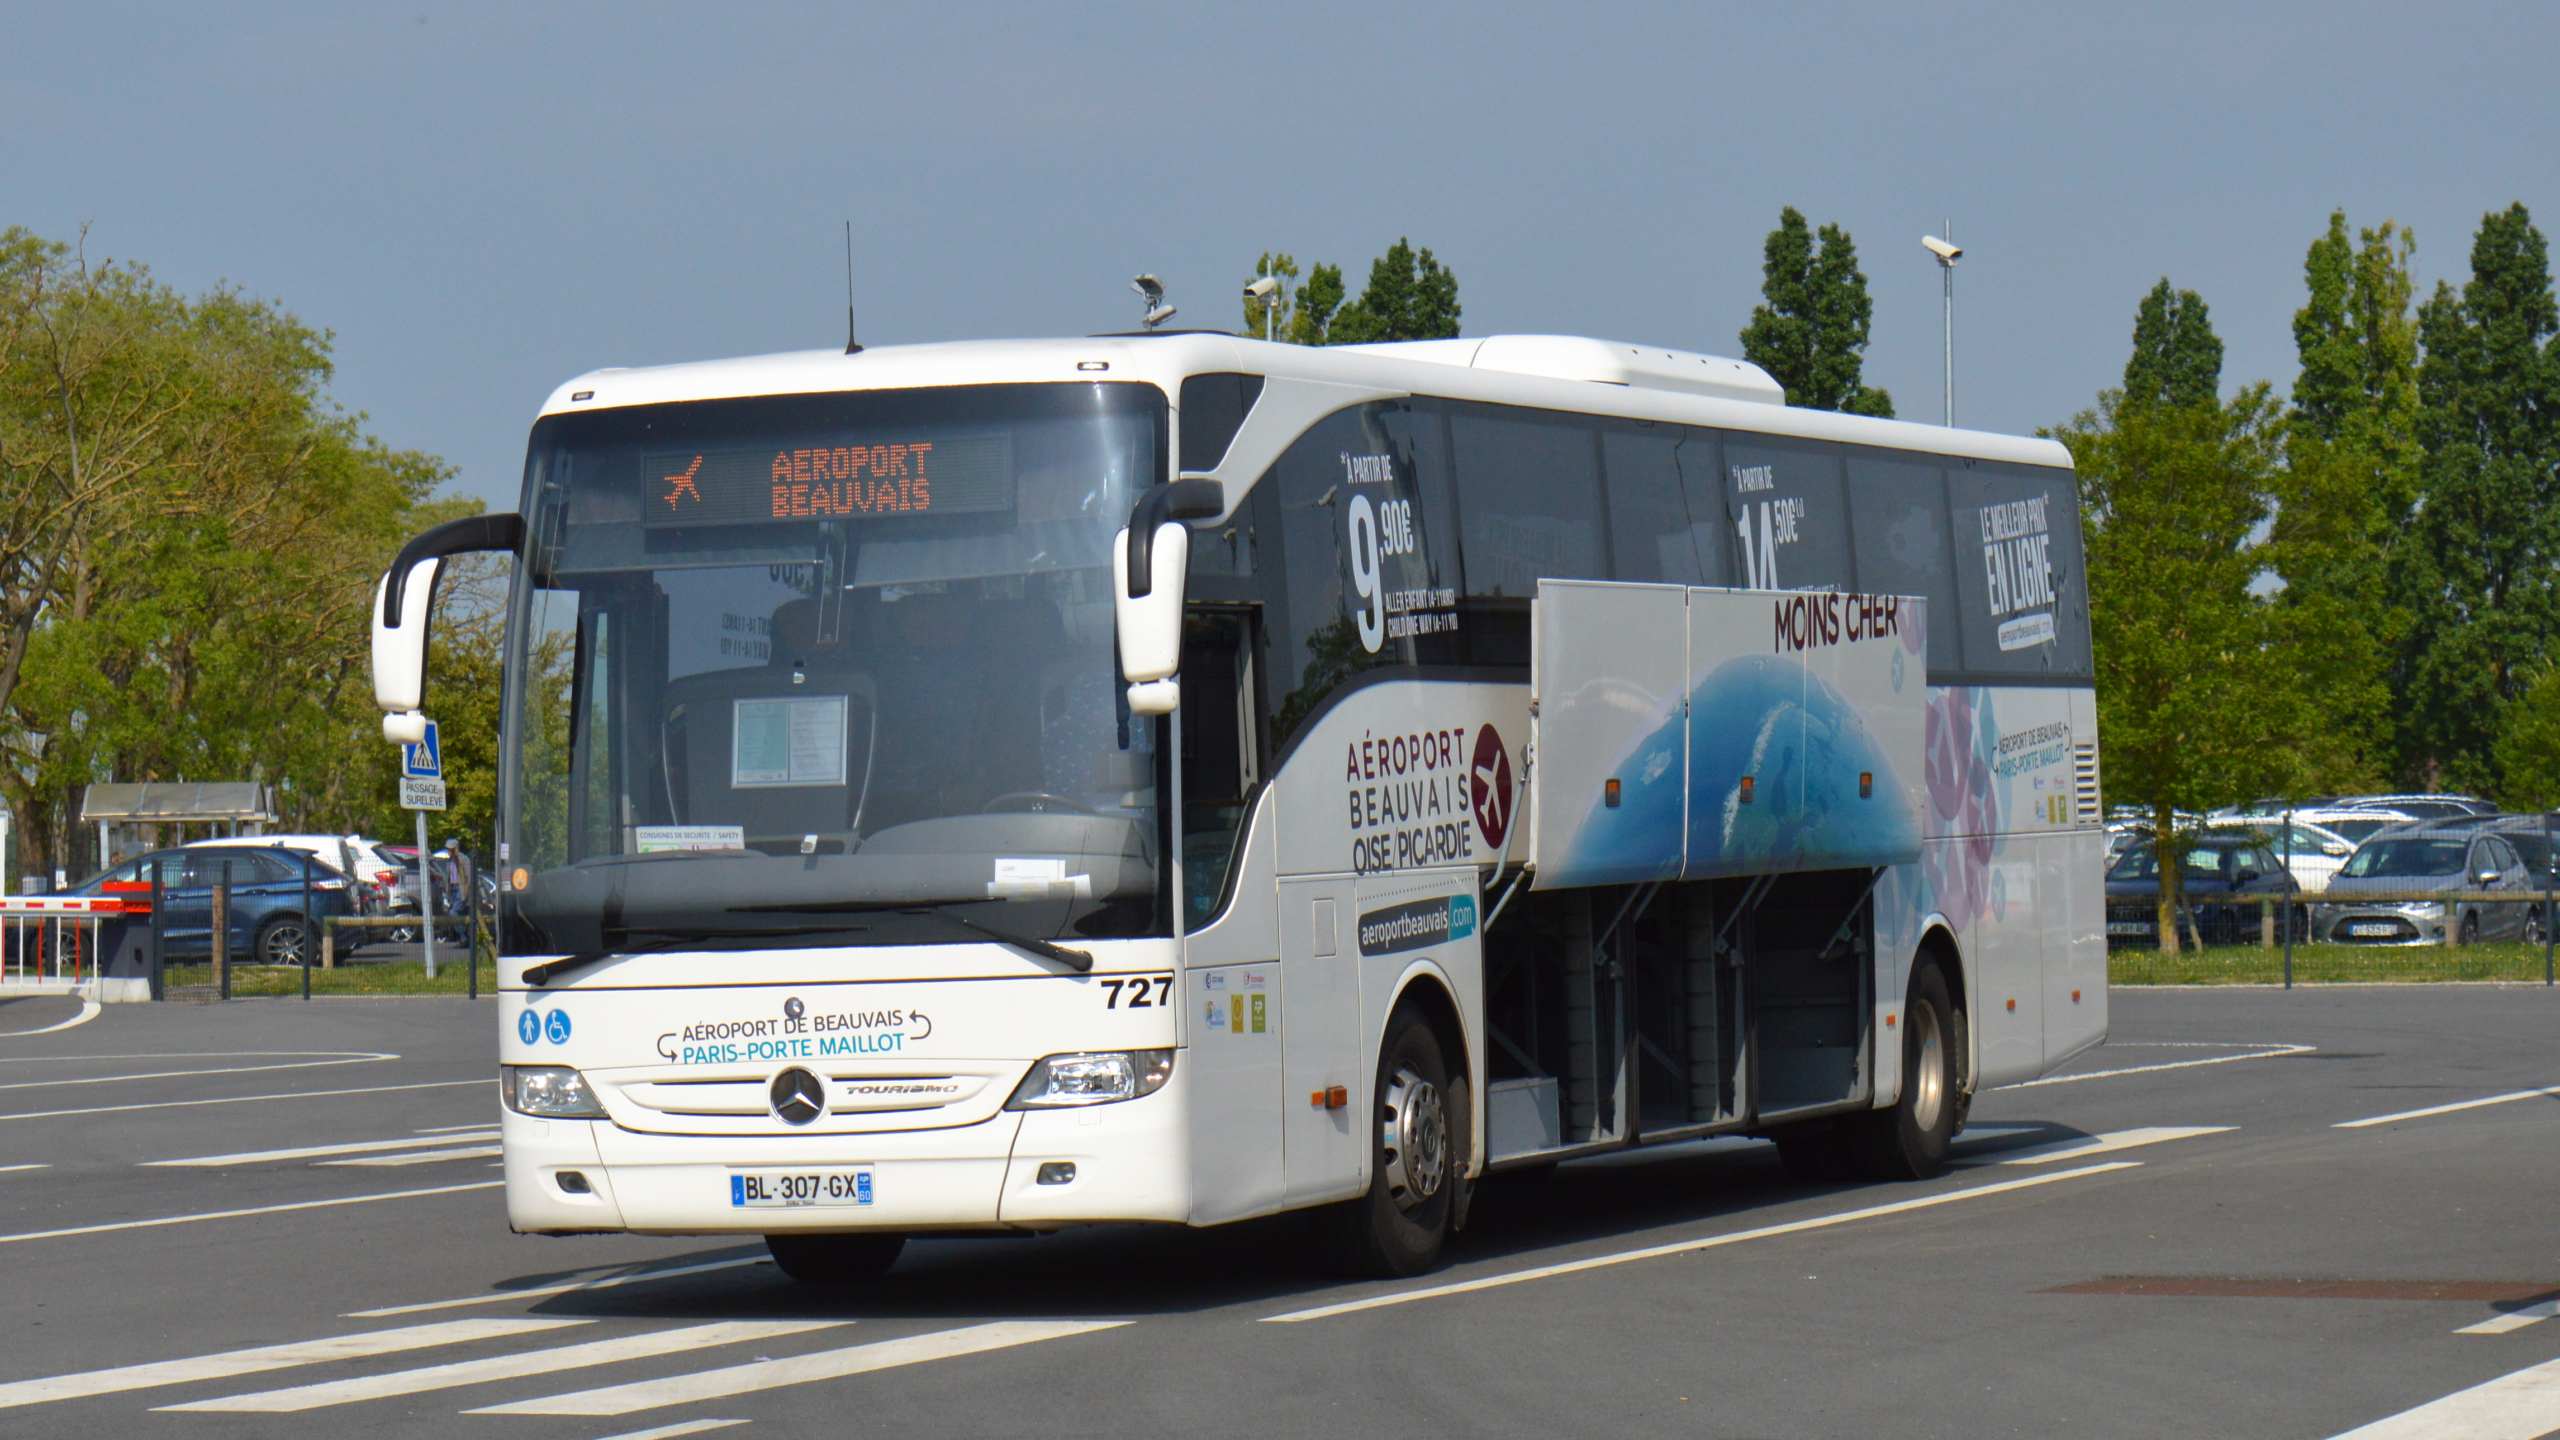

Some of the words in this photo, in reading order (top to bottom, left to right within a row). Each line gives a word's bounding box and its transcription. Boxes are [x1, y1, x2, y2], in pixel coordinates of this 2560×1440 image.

[772, 443, 932, 482] AEROPORT
[1353, 455, 1381, 483] PARTIR
[1381, 454, 1393, 481] DE
[1742, 466, 1765, 492] PARTIR
[1764, 465, 1774, 489] DE
[773, 478, 930, 517] BEAUVAIS
[1980, 507, 1992, 543] LE
[1990, 500, 2029, 541] MEILLEUR
[1984, 542, 2010, 616] EN
[2007, 534, 2056, 610] LIGNE
[1386, 592, 1404, 613] ALLER
[1404, 589, 1427, 611] ENFANT
[1388, 616, 1406, 638] CHILD
[1406, 614, 1419, 636] ONE
[1419, 612, 1432, 634] WAY
[1775, 593, 1839, 654] MOINS
[1846, 593, 1898, 642] CHER
[2028, 729, 2036, 746] DE
[2037, 722, 2062, 743] BEAUVAIS
[1347, 729, 1465, 783] AÉROPORT
[2000, 752, 2039, 779] PARIS-PORTE
[2040, 743, 2063, 766] MAILLOT
[406, 782, 438, 794] PASSAGE
[406, 794, 443, 807] SURELEVE
[1349, 773, 1469, 829] BEAUVAIS
[1353, 820, 1472, 876] OISE/PICARDIE
[1362, 907, 1472, 947] aeroportbeauvais.com
[1101, 976, 1173, 1010] 727
[682, 1020, 778, 1042] AÉROPORT
[784, 1017, 808, 1034] DE
[814, 1010, 903, 1032] BEAUVAIS
[683, 1039, 813, 1065] PARIS-PORTE
[819, 1033, 904, 1056] MAILLOT
[847, 1084, 959, 1095] TOURISMO
[745, 1174, 856, 1200] BL-307-GX
[859, 1190, 871, 1201] 60
